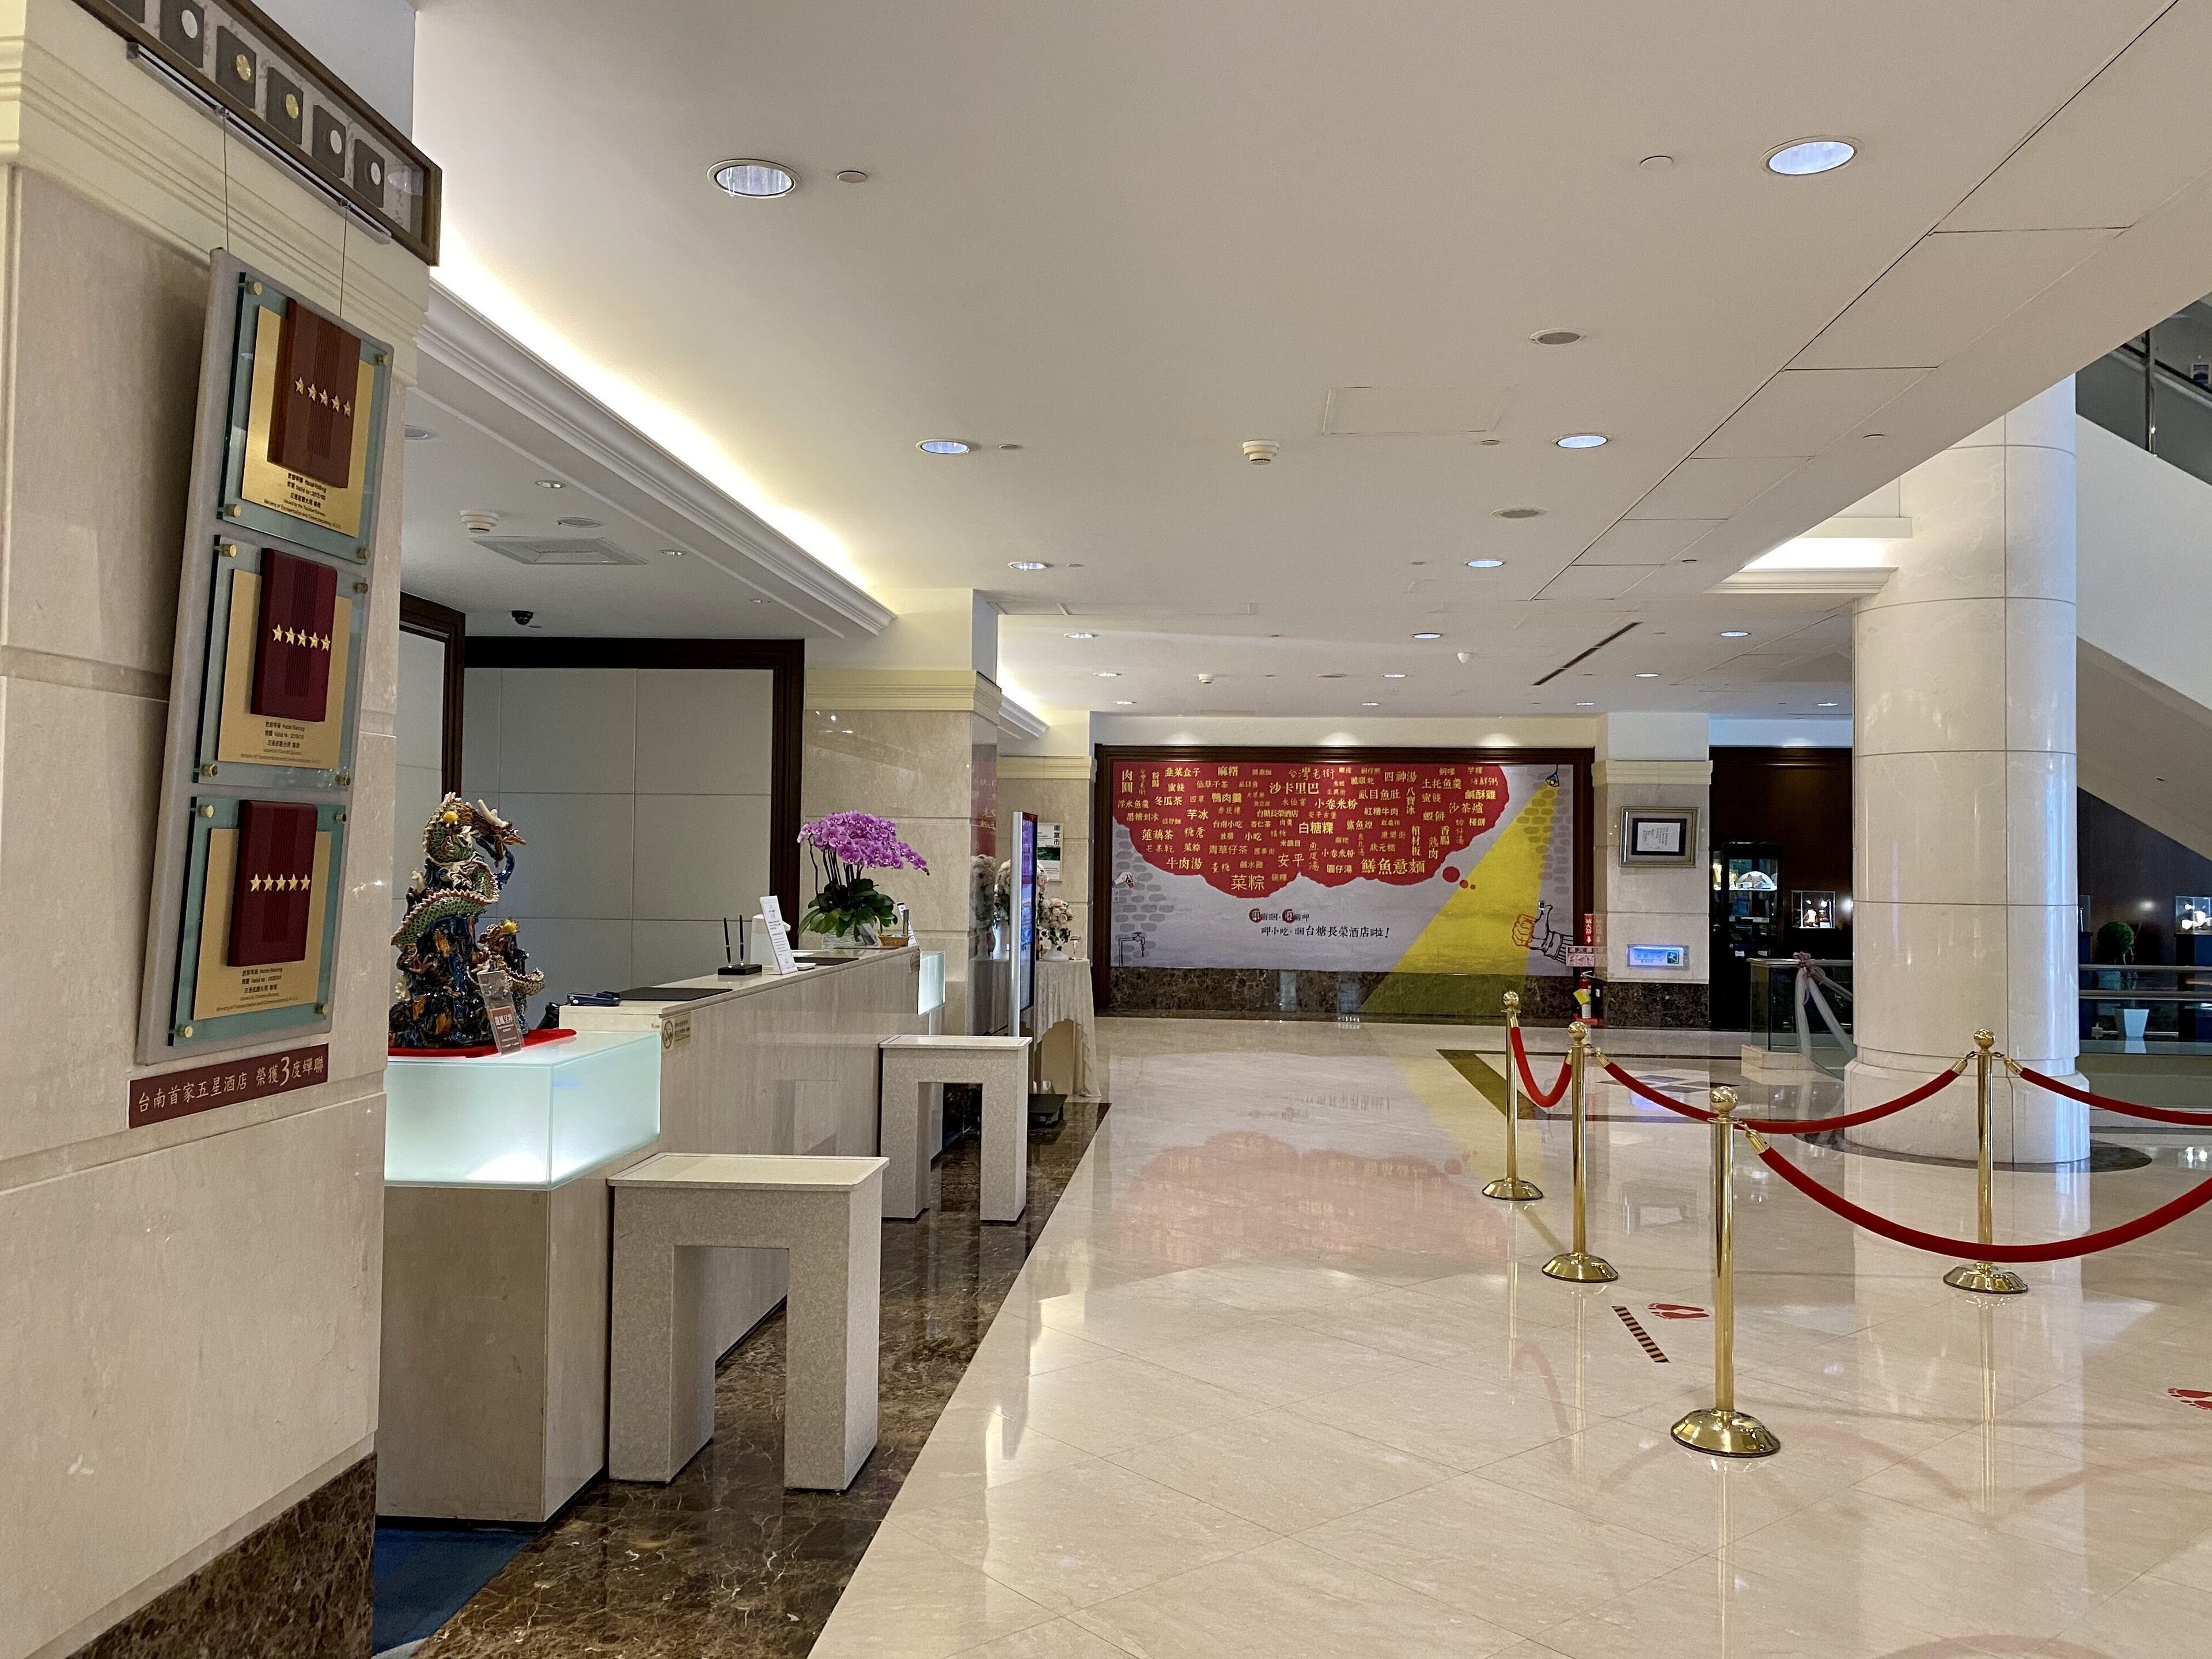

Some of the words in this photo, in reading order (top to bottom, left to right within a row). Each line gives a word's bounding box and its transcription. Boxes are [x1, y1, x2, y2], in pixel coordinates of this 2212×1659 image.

[1164, 767, 1200, 778] 韭菜盒子
[1384, 771, 1417, 783] 四神湯
[1268, 782, 1320, 795] 沙卡里巴
[1154, 796, 1183, 806] 冬瓜茶
[1315, 798, 1358, 810] 小卷米粉
[1406, 787, 1416, 815] 八寶冰
[1187, 809, 1209, 820] 芋冰
[1364, 807, 1399, 816] 紅糟牛肉
[1213, 820, 1243, 829] 台南小吃
[1244, 831, 1262, 842] 小吃
[1412, 825, 1421, 857] 棺材板
[1440, 825, 1450, 846] 香腸
[1428, 836, 1439, 860] 熟肉
[1166, 856, 1203, 870] 牛肉湯
[1277, 853, 1304, 868] 安平
[1360, 857, 1425, 875] 鱔魚意麵
[1230, 874, 1265, 891] 菜粽
[138, 1072, 247, 1113] 台南首家五星酒店
[255, 1056, 324, 1087] 榮獲3度蟬聯
